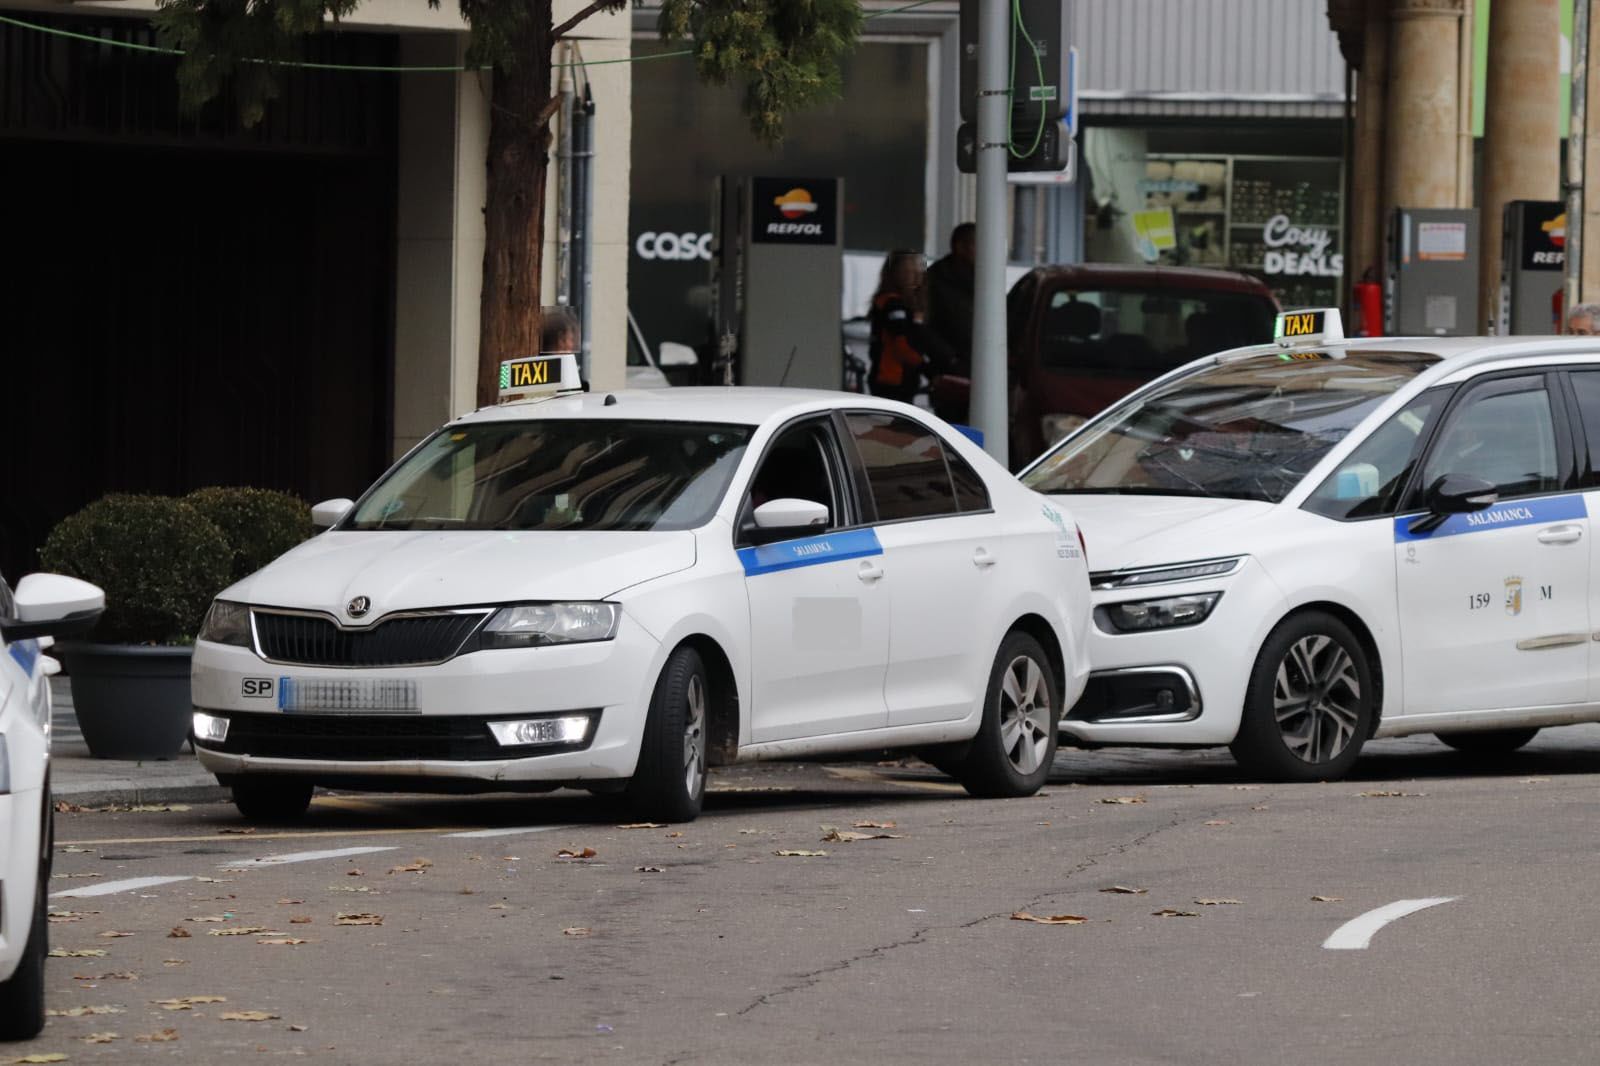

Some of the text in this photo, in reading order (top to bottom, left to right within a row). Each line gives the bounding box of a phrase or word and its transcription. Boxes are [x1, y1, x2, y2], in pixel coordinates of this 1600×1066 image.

[767, 222, 822, 235] REPSOL
[1263, 214, 1331, 259] Cosy
[1263, 252, 1344, 277] DEALS
[1285, 313, 1315, 336] TAXI
[511, 361, 548, 386] TAXI
[1465, 507, 1534, 526] SALAMANCA
[1468, 585, 1553, 610] 159 M
[243, 680, 272, 695] SP
